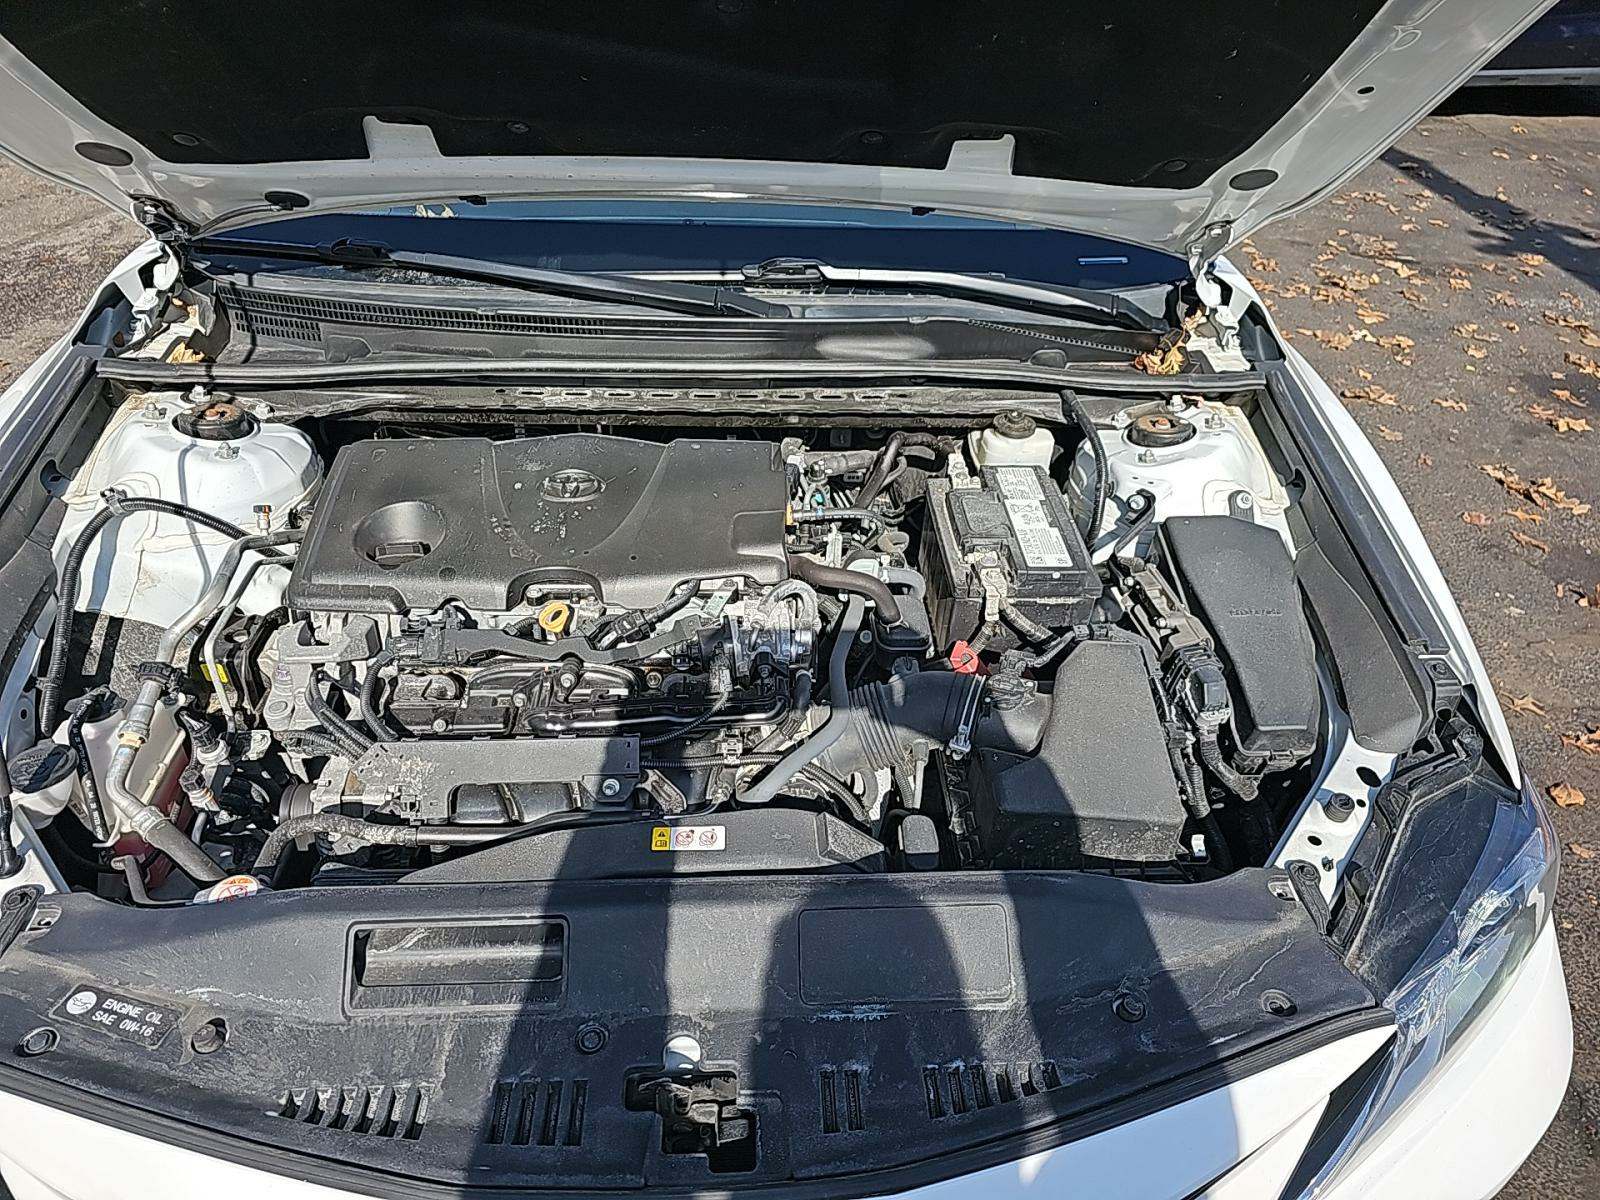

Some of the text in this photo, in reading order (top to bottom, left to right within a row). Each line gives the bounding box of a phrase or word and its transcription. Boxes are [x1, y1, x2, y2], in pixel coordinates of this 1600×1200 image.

[92, 1010, 155, 1037] SAE 0W-16
[101, 998, 164, 1025] ENGINE OIL
